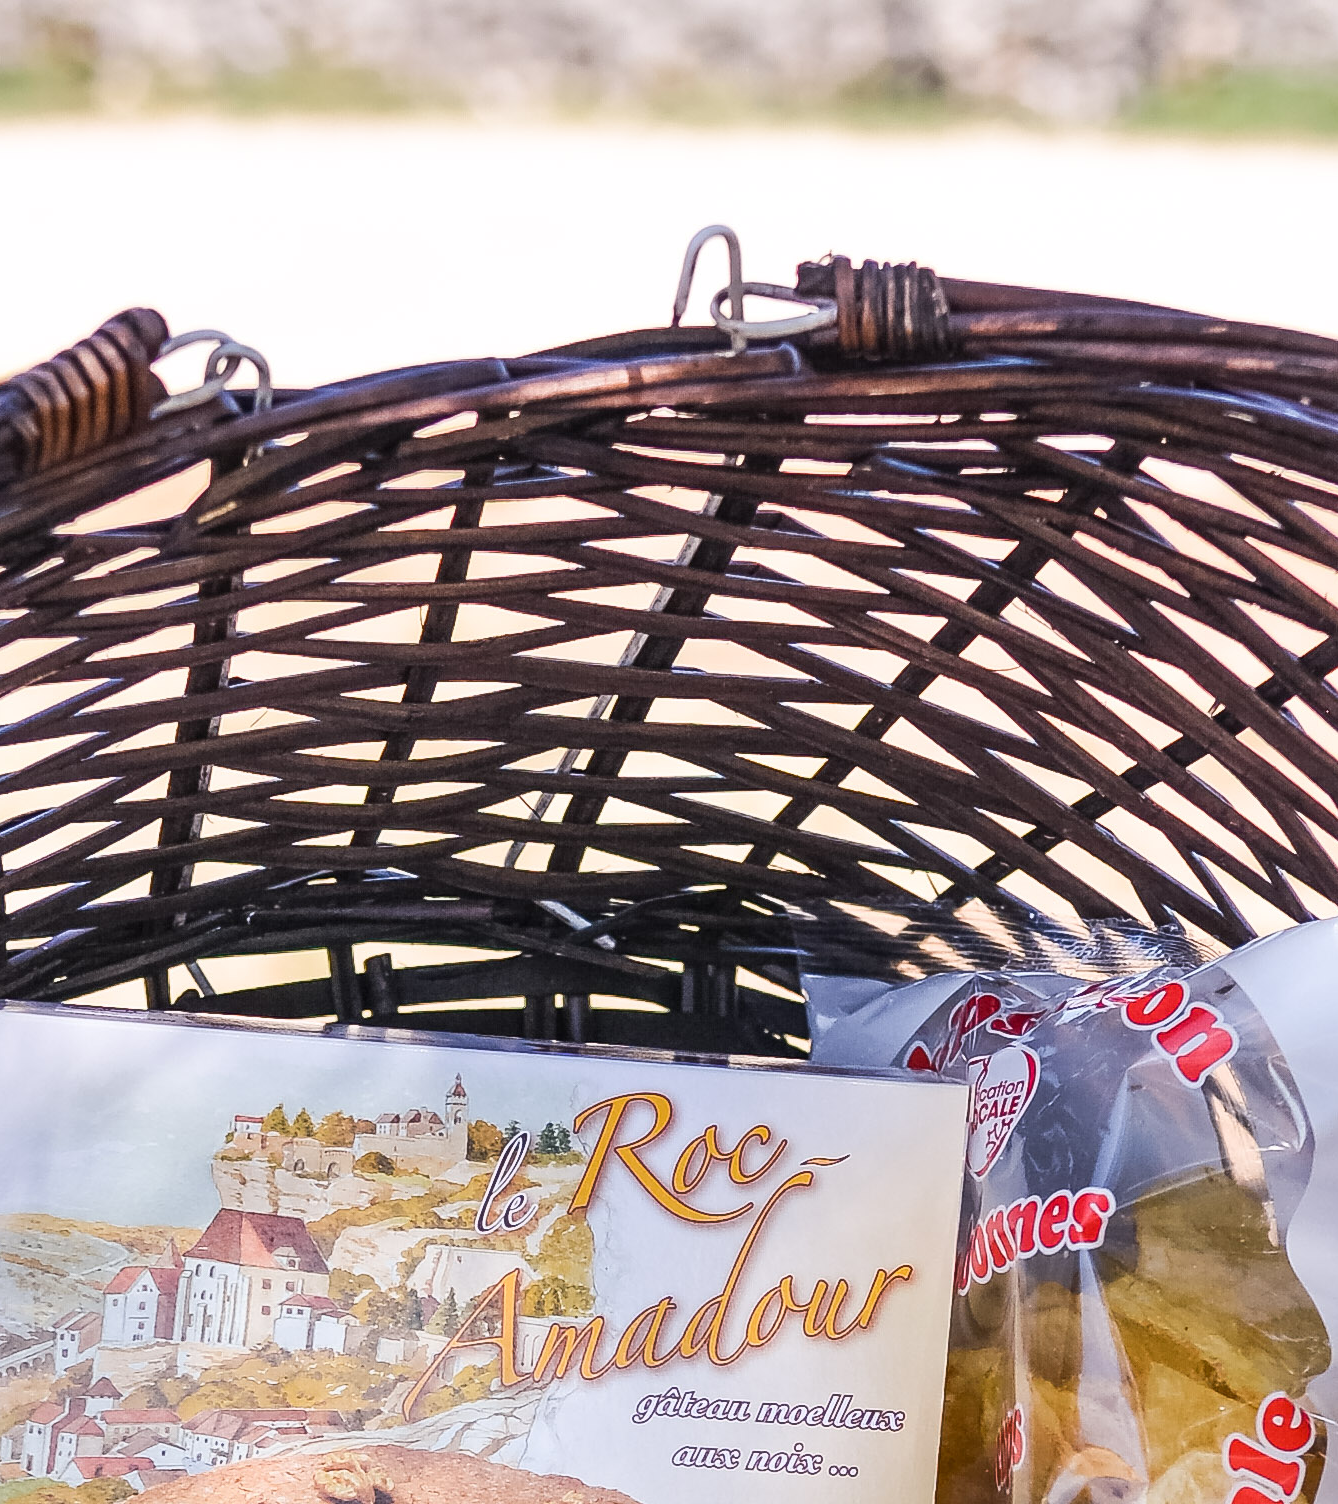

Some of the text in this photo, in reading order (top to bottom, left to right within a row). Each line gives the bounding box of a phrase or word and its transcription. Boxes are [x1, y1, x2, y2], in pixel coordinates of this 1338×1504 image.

[475, 1131, 537, 1235] le
[403, 1171, 913, 1424] Amadour
[631, 1387, 907, 1432] gâteau moelleux
[671, 1442, 741, 1470] aux
[746, 1441, 823, 1477] noix
